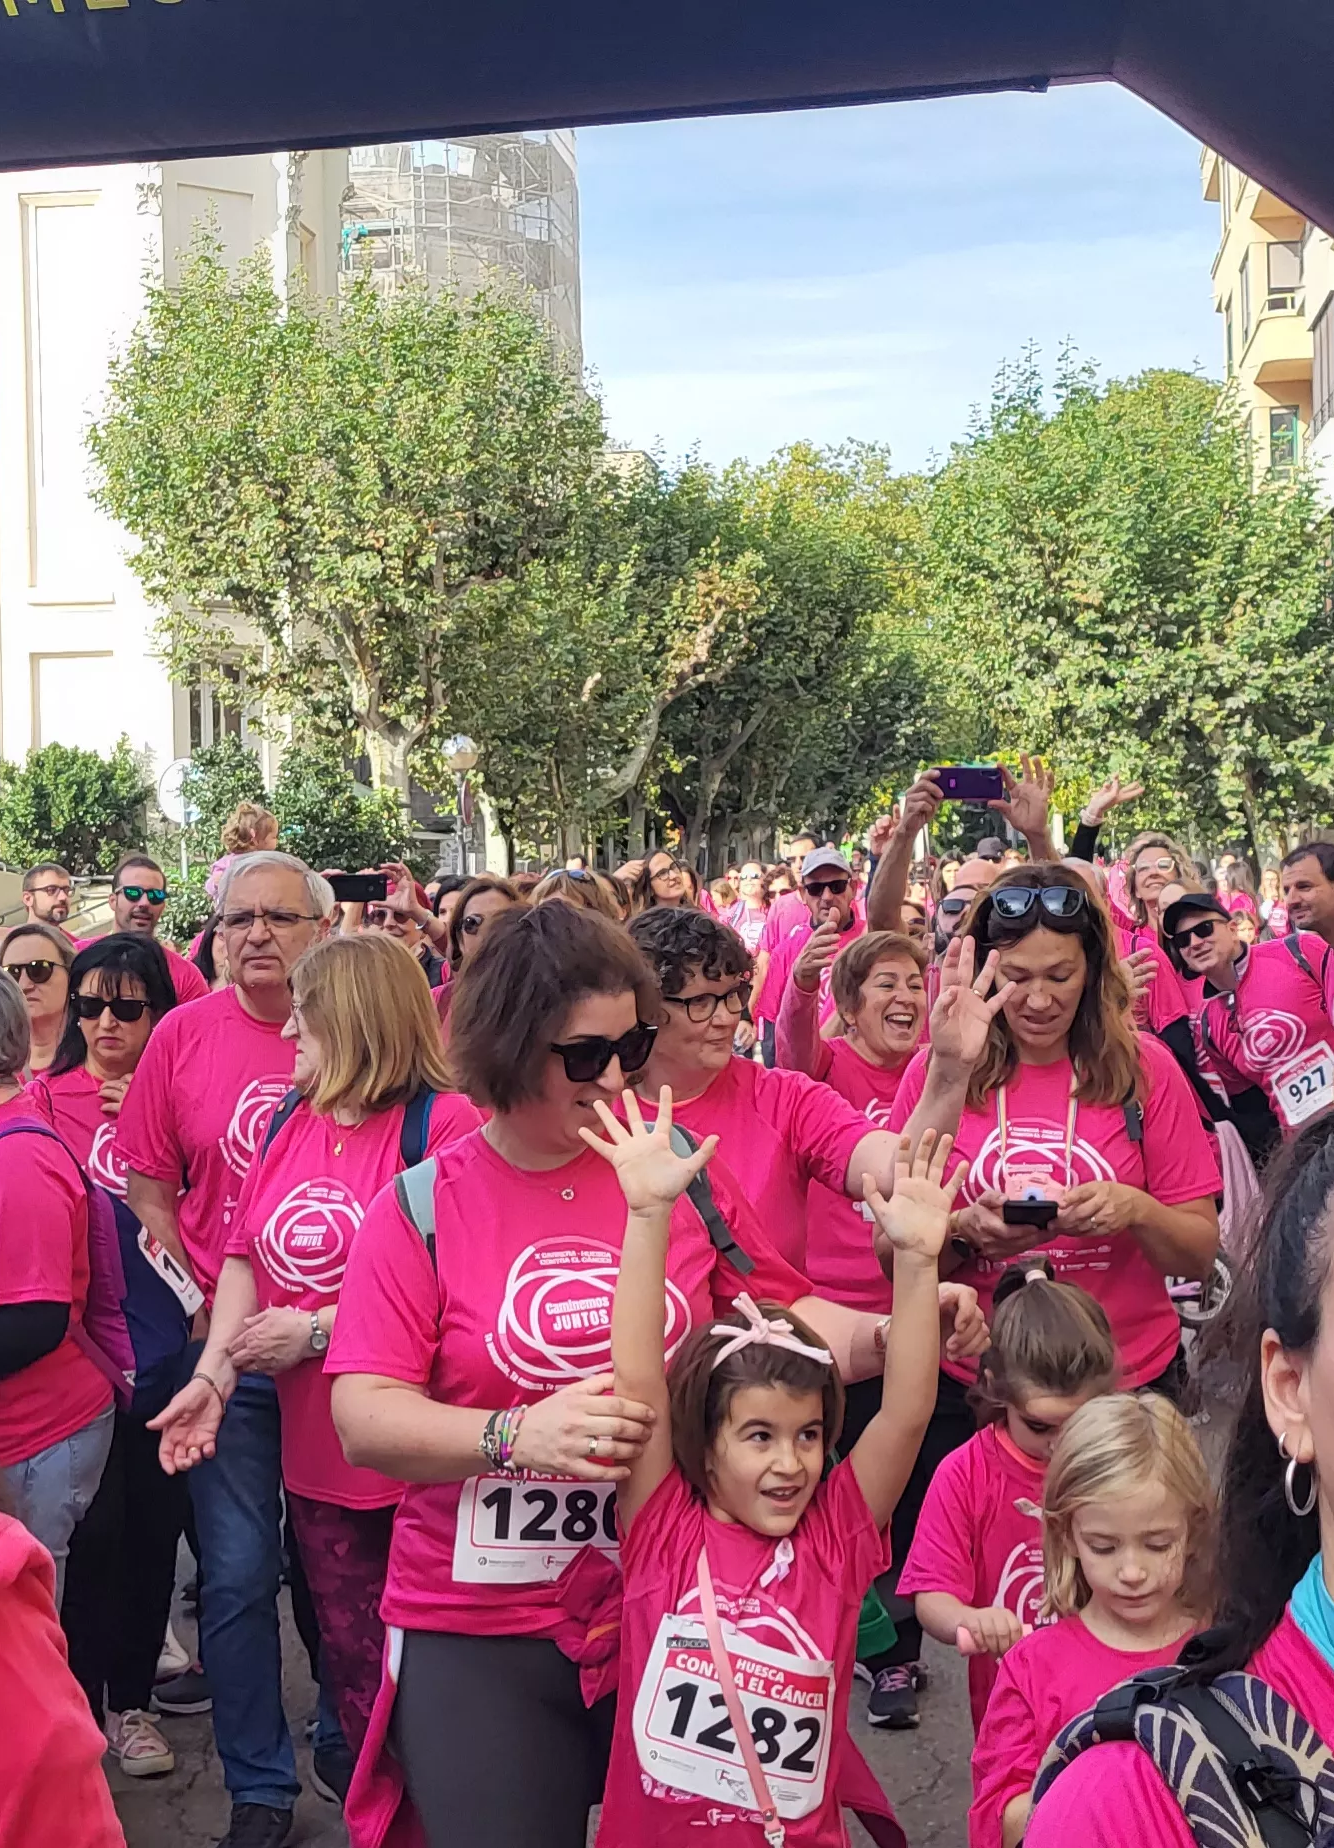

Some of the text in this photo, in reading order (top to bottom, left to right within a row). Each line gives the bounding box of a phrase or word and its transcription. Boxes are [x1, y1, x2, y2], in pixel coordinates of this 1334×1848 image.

[1289, 1066, 1327, 1104] 927
[544, 1296, 610, 1315] Caminemos
[552, 1308, 610, 1331] JUNTOS
[676, 1653, 745, 1690] CONA
[747, 1678, 767, 1695] EL
[736, 1658, 785, 1684] HUESCA
[665, 1681, 822, 1774] 1282
